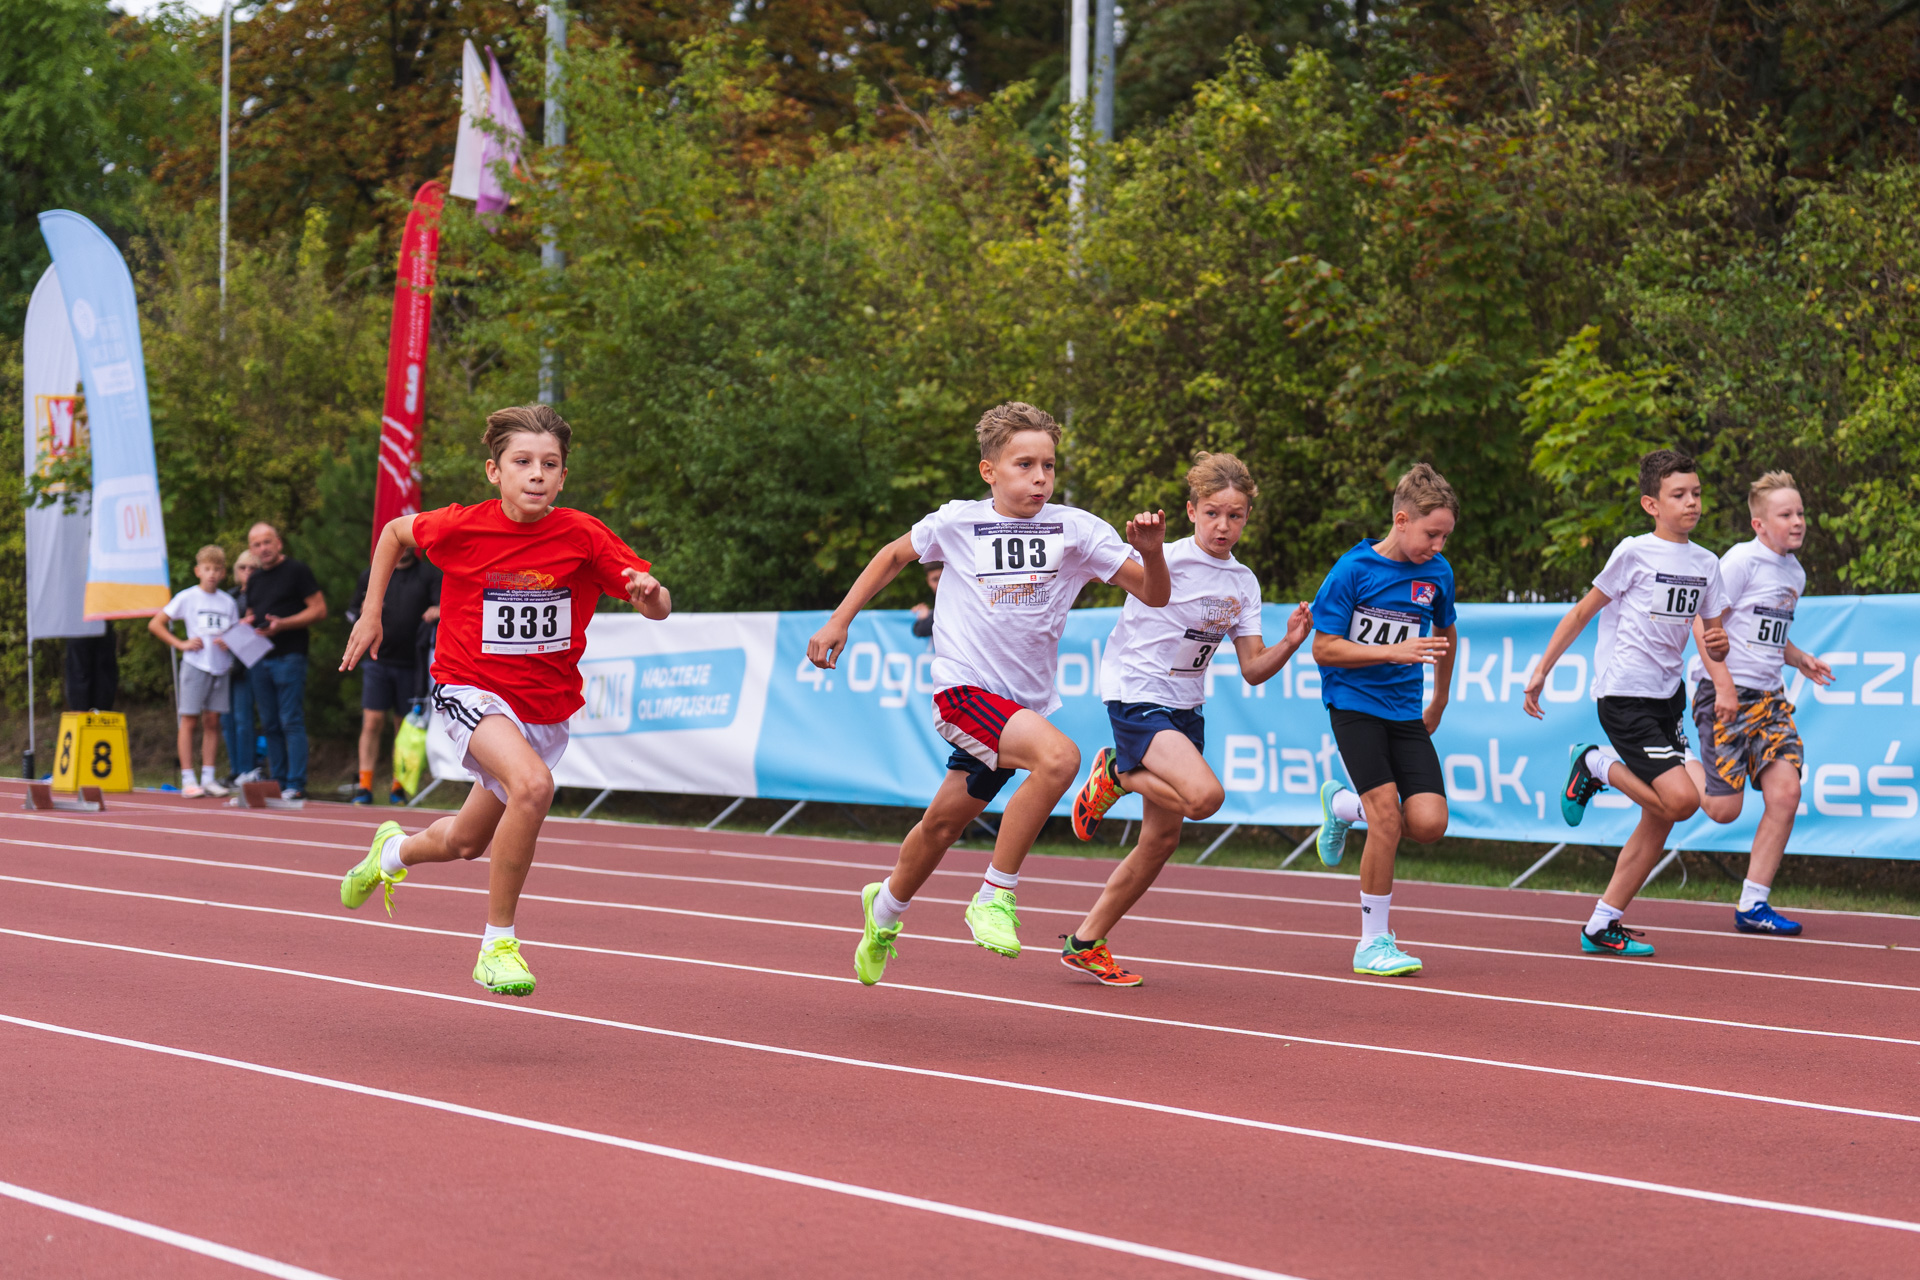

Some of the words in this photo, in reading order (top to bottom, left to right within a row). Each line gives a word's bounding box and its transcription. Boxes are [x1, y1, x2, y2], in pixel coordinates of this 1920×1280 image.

[991, 537, 1047, 570] 193
[1666, 587, 1700, 613] 163
[497, 605, 558, 639] 333
[1356, 617, 1409, 646] 244
[1192, 644, 1218, 668] 3
[640, 664, 712, 689] NADZIEJE
[796, 653, 833, 692] 4.
[637, 693, 731, 721] OLIMPIJSKIE
[60, 730, 72, 776] 8
[91, 741, 112, 779] 8
